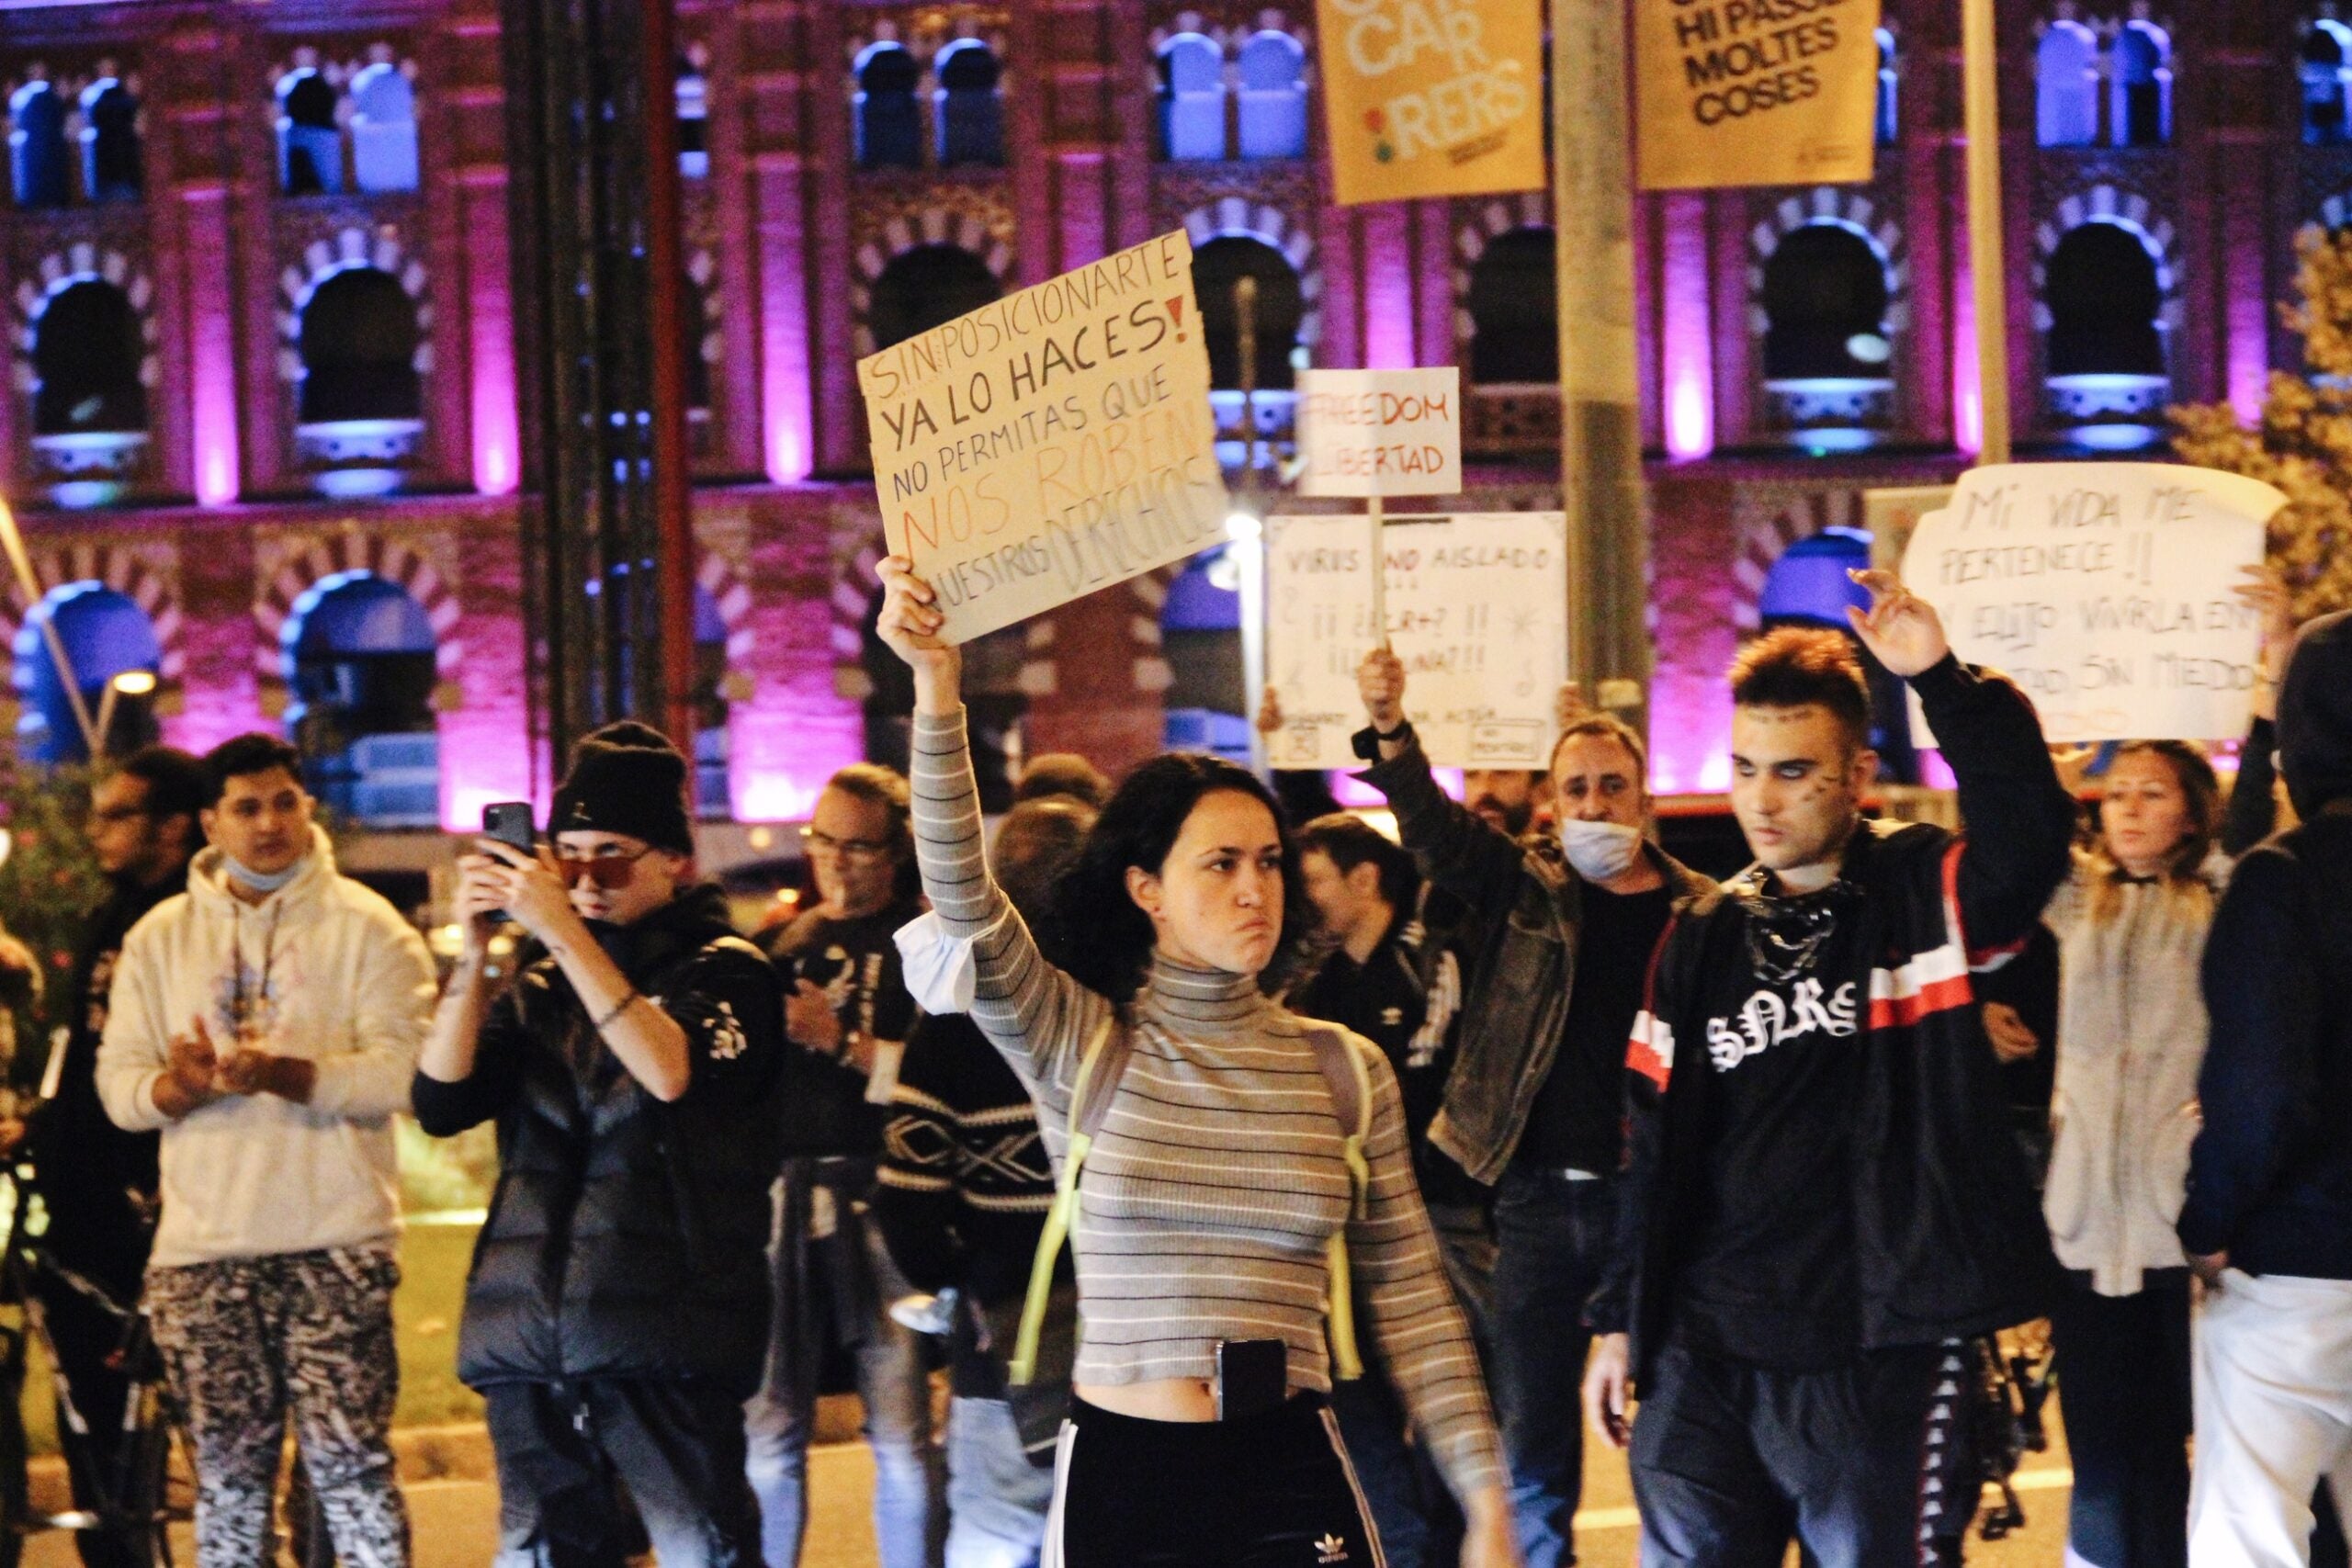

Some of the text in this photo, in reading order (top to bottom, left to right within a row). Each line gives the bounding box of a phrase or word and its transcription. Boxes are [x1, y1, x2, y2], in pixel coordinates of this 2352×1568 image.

[1345, 0, 1487, 76] CAR
[1673, 8, 1720, 47] HI
[1684, 17, 1839, 87] MOLTES
[1386, 58, 1526, 161] RERS
[1694, 65, 1820, 126] COSES
[881, 295, 1188, 452] YA LO HACES!
[893, 364, 1173, 502] NO PERMITAS QUE
[903, 400, 1200, 563] NOS ROBEN
[1383, 549, 1420, 571] NO
